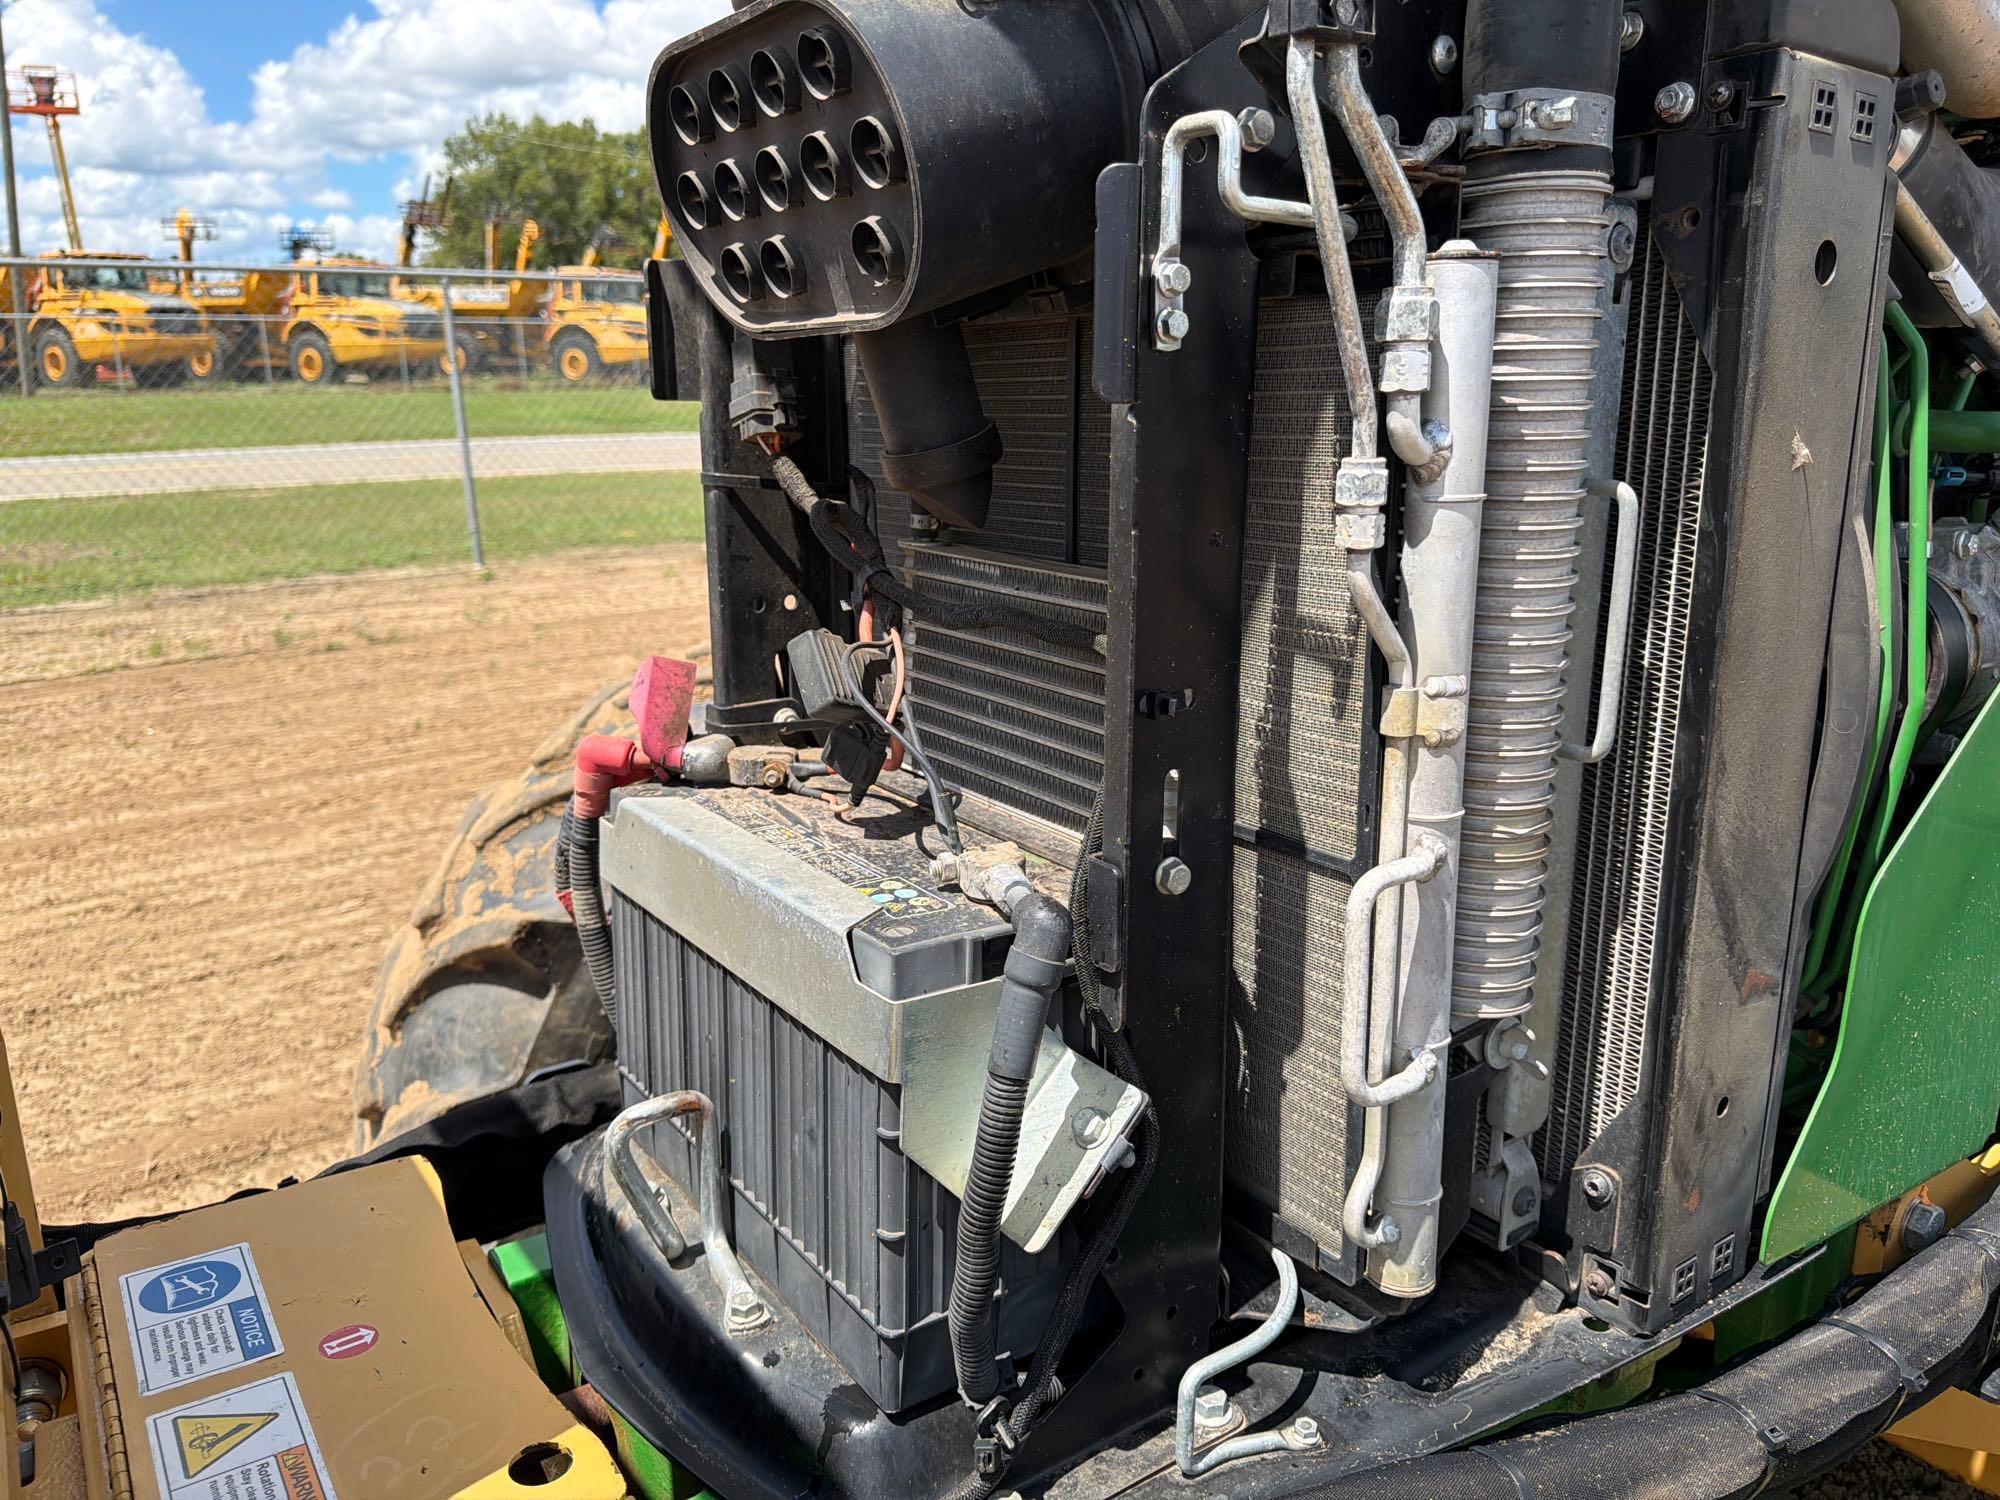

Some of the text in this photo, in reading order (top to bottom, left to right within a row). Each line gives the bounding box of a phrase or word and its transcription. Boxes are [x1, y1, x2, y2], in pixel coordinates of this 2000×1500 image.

[175, 1320, 194, 1375] Serious damage may
[187, 1316, 200, 1340] tightness
[195, 1341, 206, 1352] and
[202, 1313, 220, 1354] adapter daily for
[215, 1309, 235, 1353] Check crankshaft
[238, 1308, 265, 1348] NOTICE
[161, 1324, 180, 1377] result from improper
[240, 1468, 252, 1485] Stay
